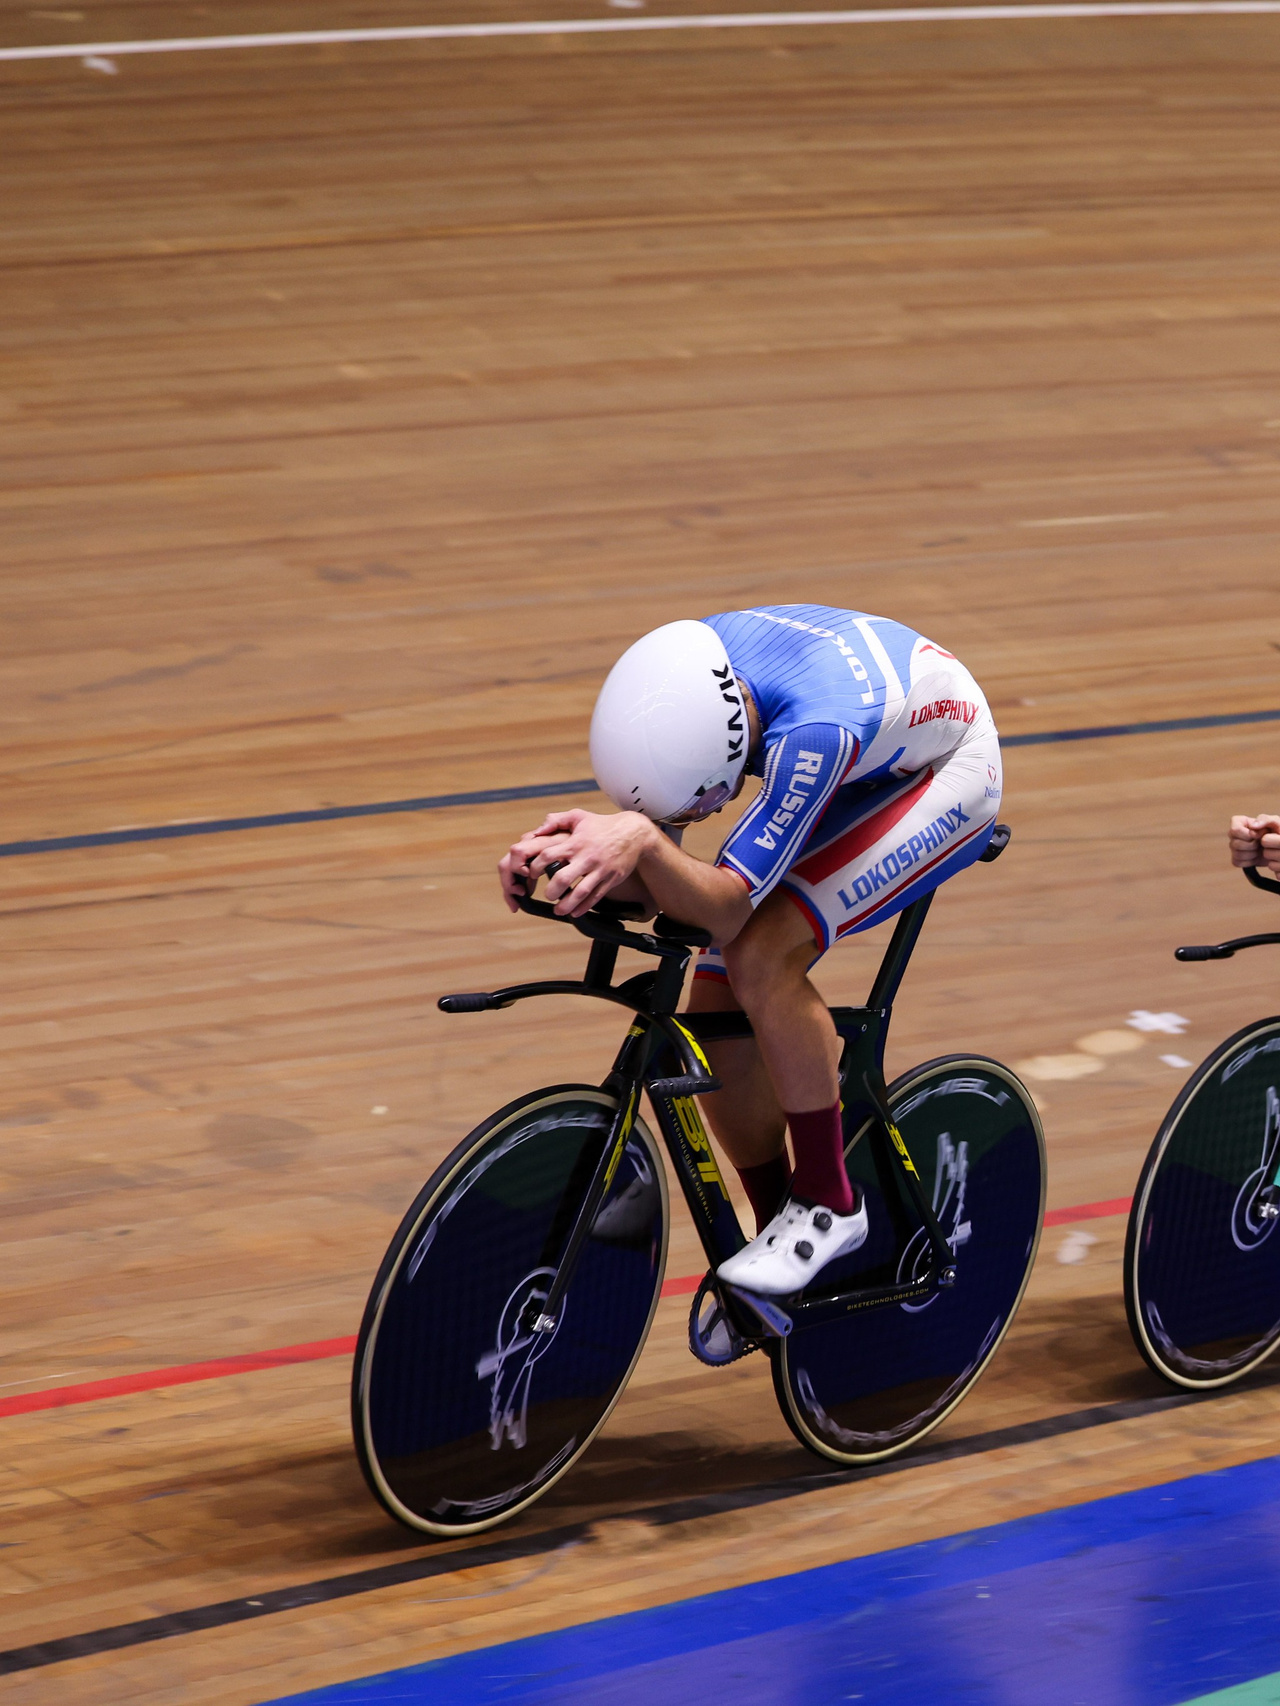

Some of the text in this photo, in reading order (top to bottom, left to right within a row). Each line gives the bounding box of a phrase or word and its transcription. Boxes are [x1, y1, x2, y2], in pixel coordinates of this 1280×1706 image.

[711, 663, 744, 762] KASK
[908, 699, 979, 728] LOKOSPHINX
[753, 749, 824, 850] RUSSIA
[984, 786, 1000, 798] Nalin
[836, 802, 971, 910] LOKOSPHINX
[694, 1181, 713, 1224] AUSTRALIA
